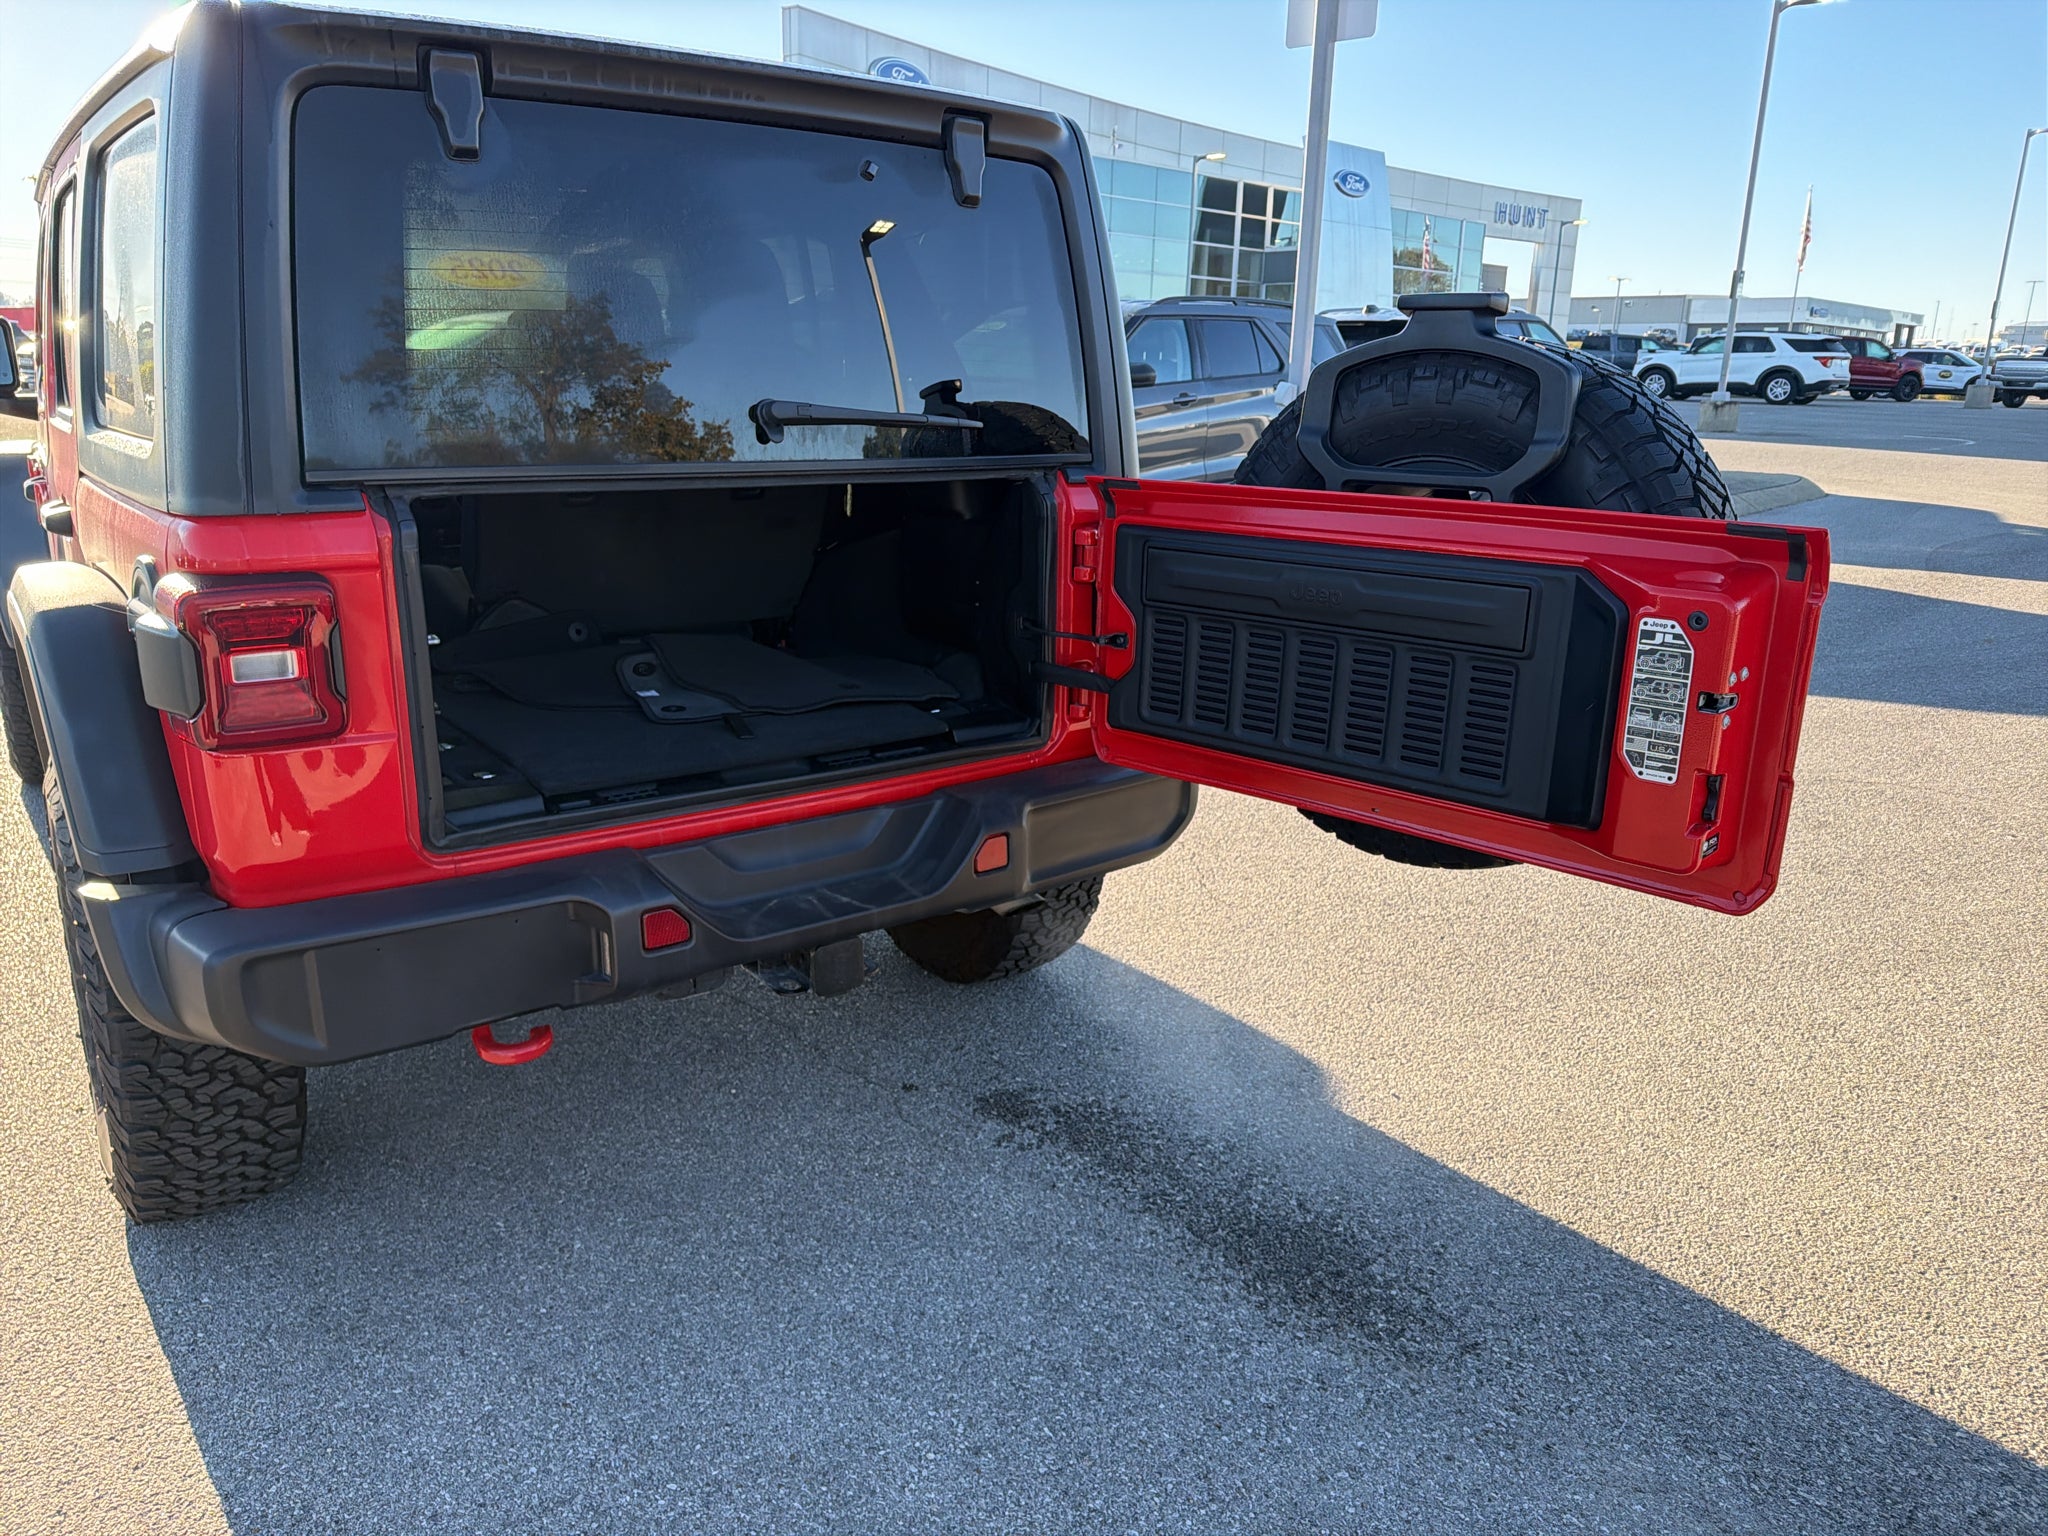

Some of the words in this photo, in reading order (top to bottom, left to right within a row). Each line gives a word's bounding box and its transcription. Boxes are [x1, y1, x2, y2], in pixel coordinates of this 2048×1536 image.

[1345, 174, 1366, 192] Ford
[1497, 202, 1549, 228] HUNT
[1289, 583, 1343, 608] Jeep
[1650, 620, 1669, 629] Jeep
[1640, 632, 1686, 645] JL
